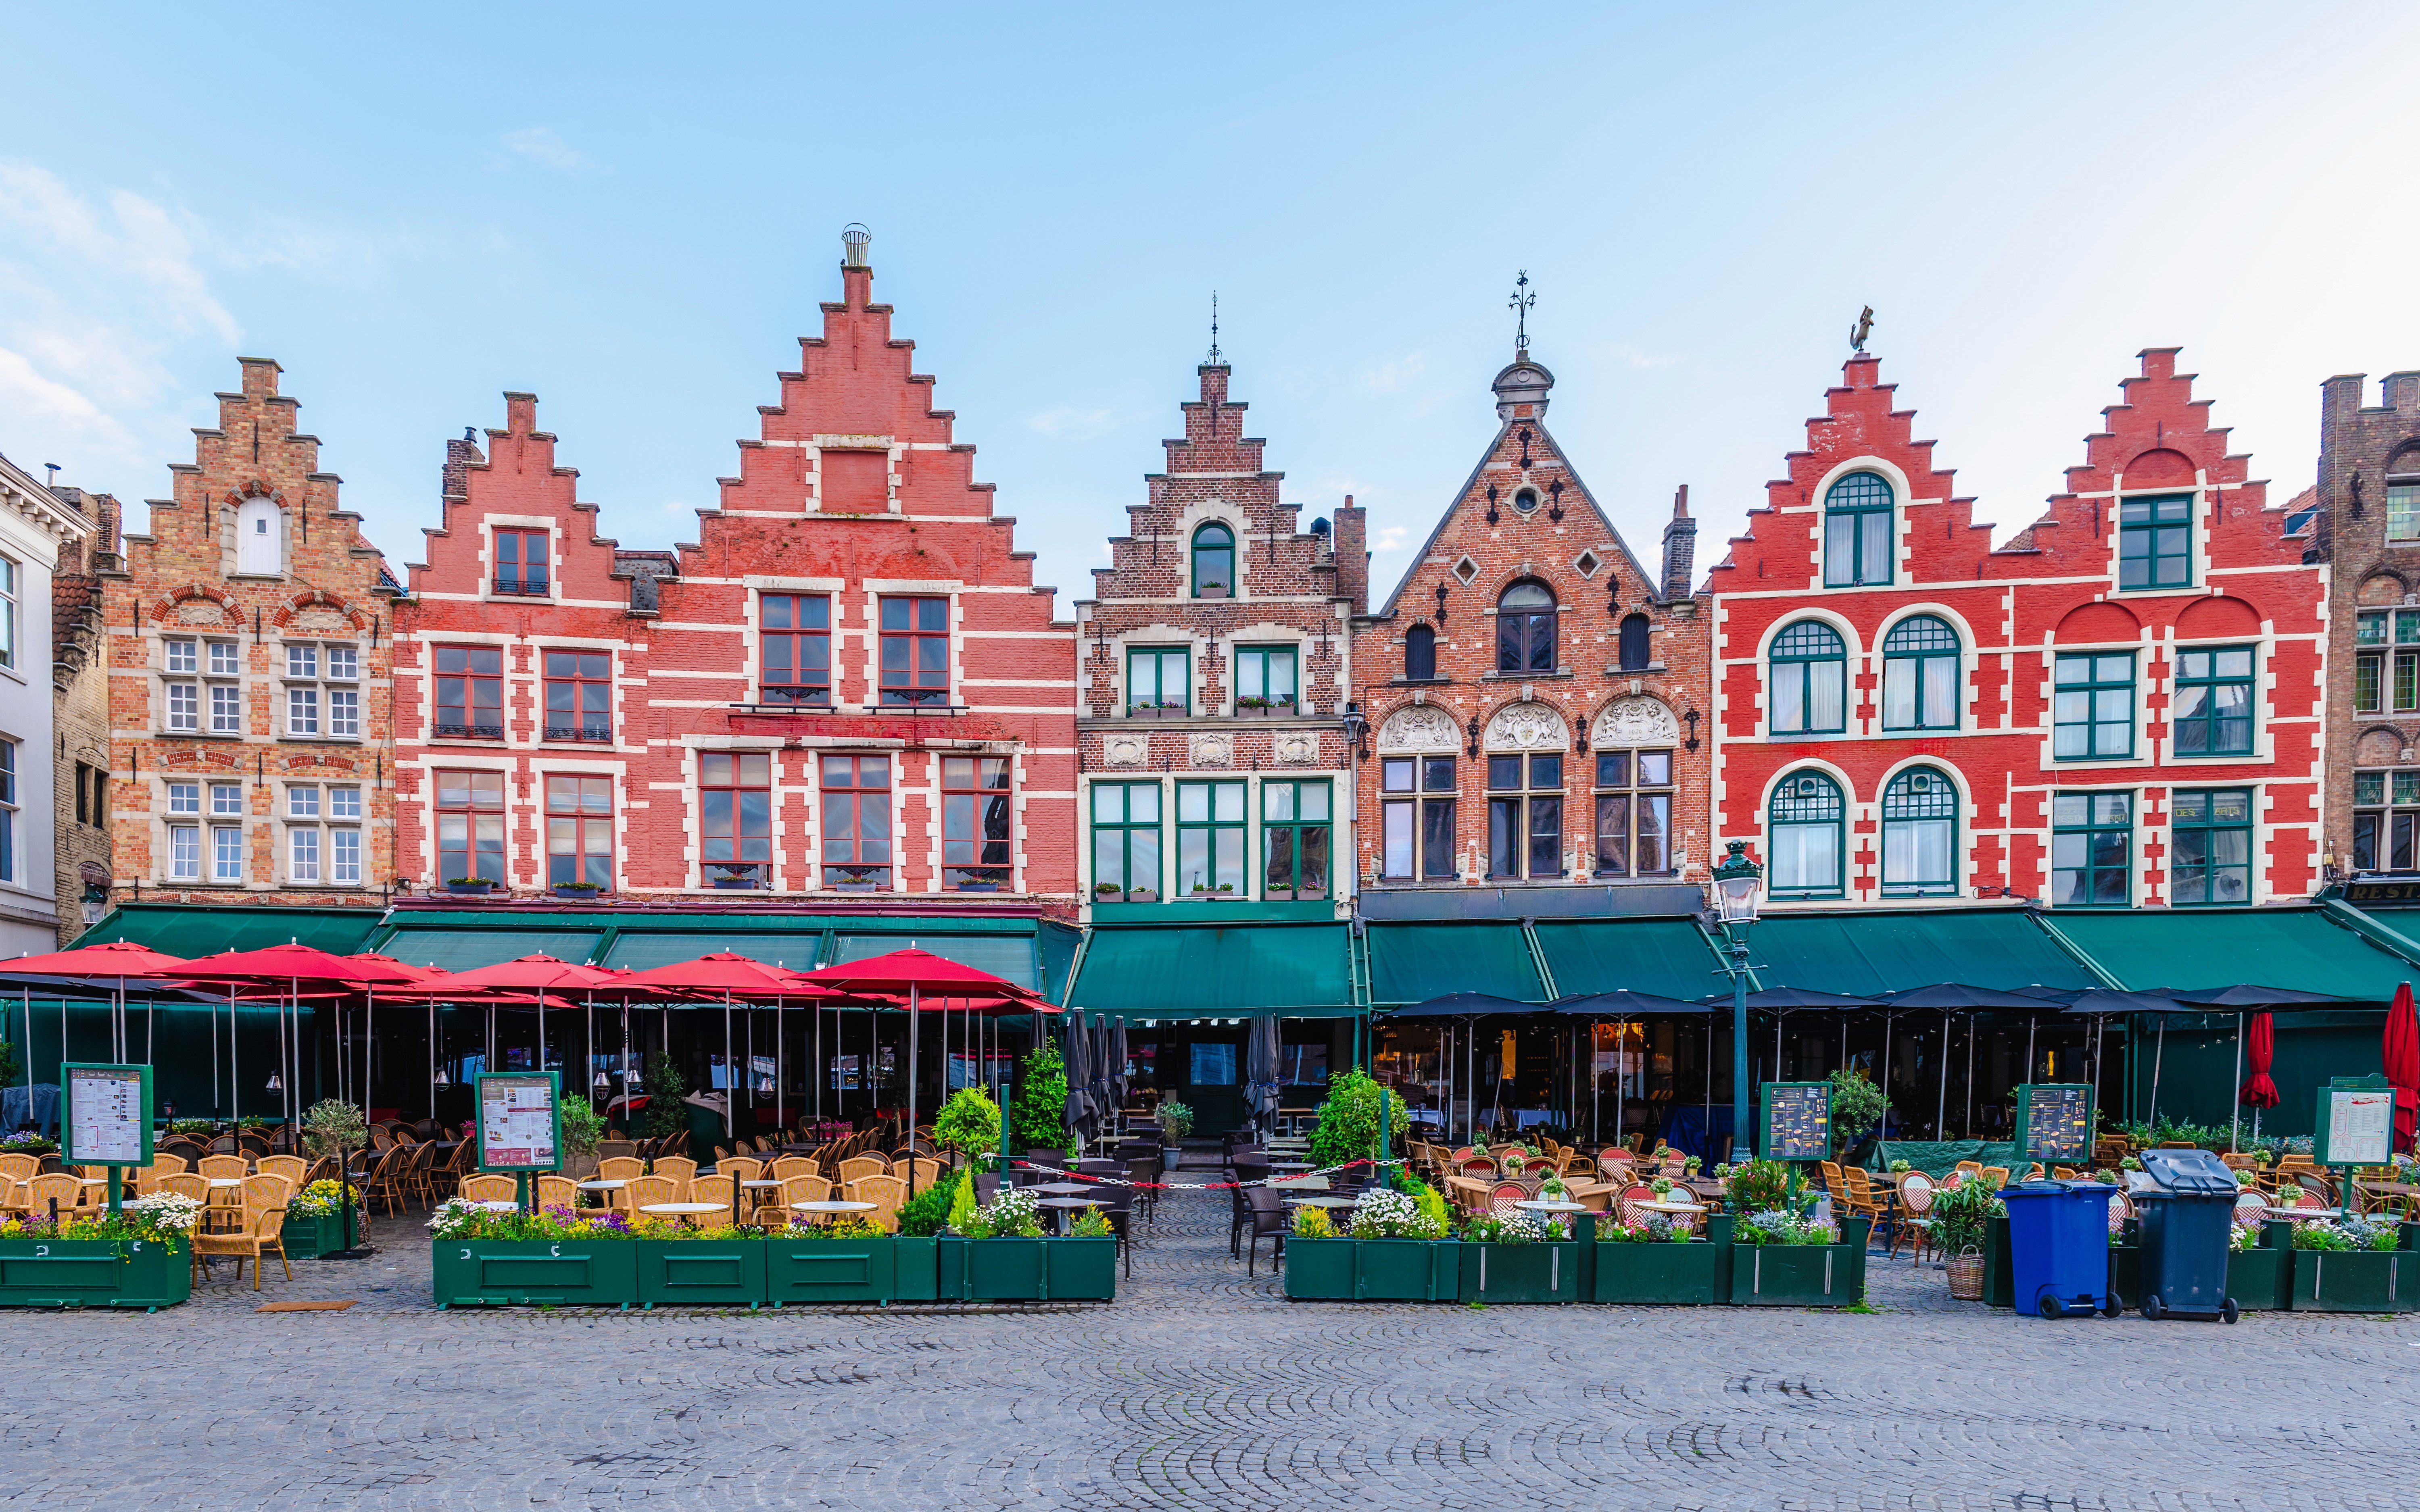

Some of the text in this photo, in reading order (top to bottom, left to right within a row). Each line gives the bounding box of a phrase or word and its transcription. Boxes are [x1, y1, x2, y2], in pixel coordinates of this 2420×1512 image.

[2175, 808, 2195, 816] DES
[2214, 806, 2240, 815] ARTS
[2351, 885, 2420, 900] REST
